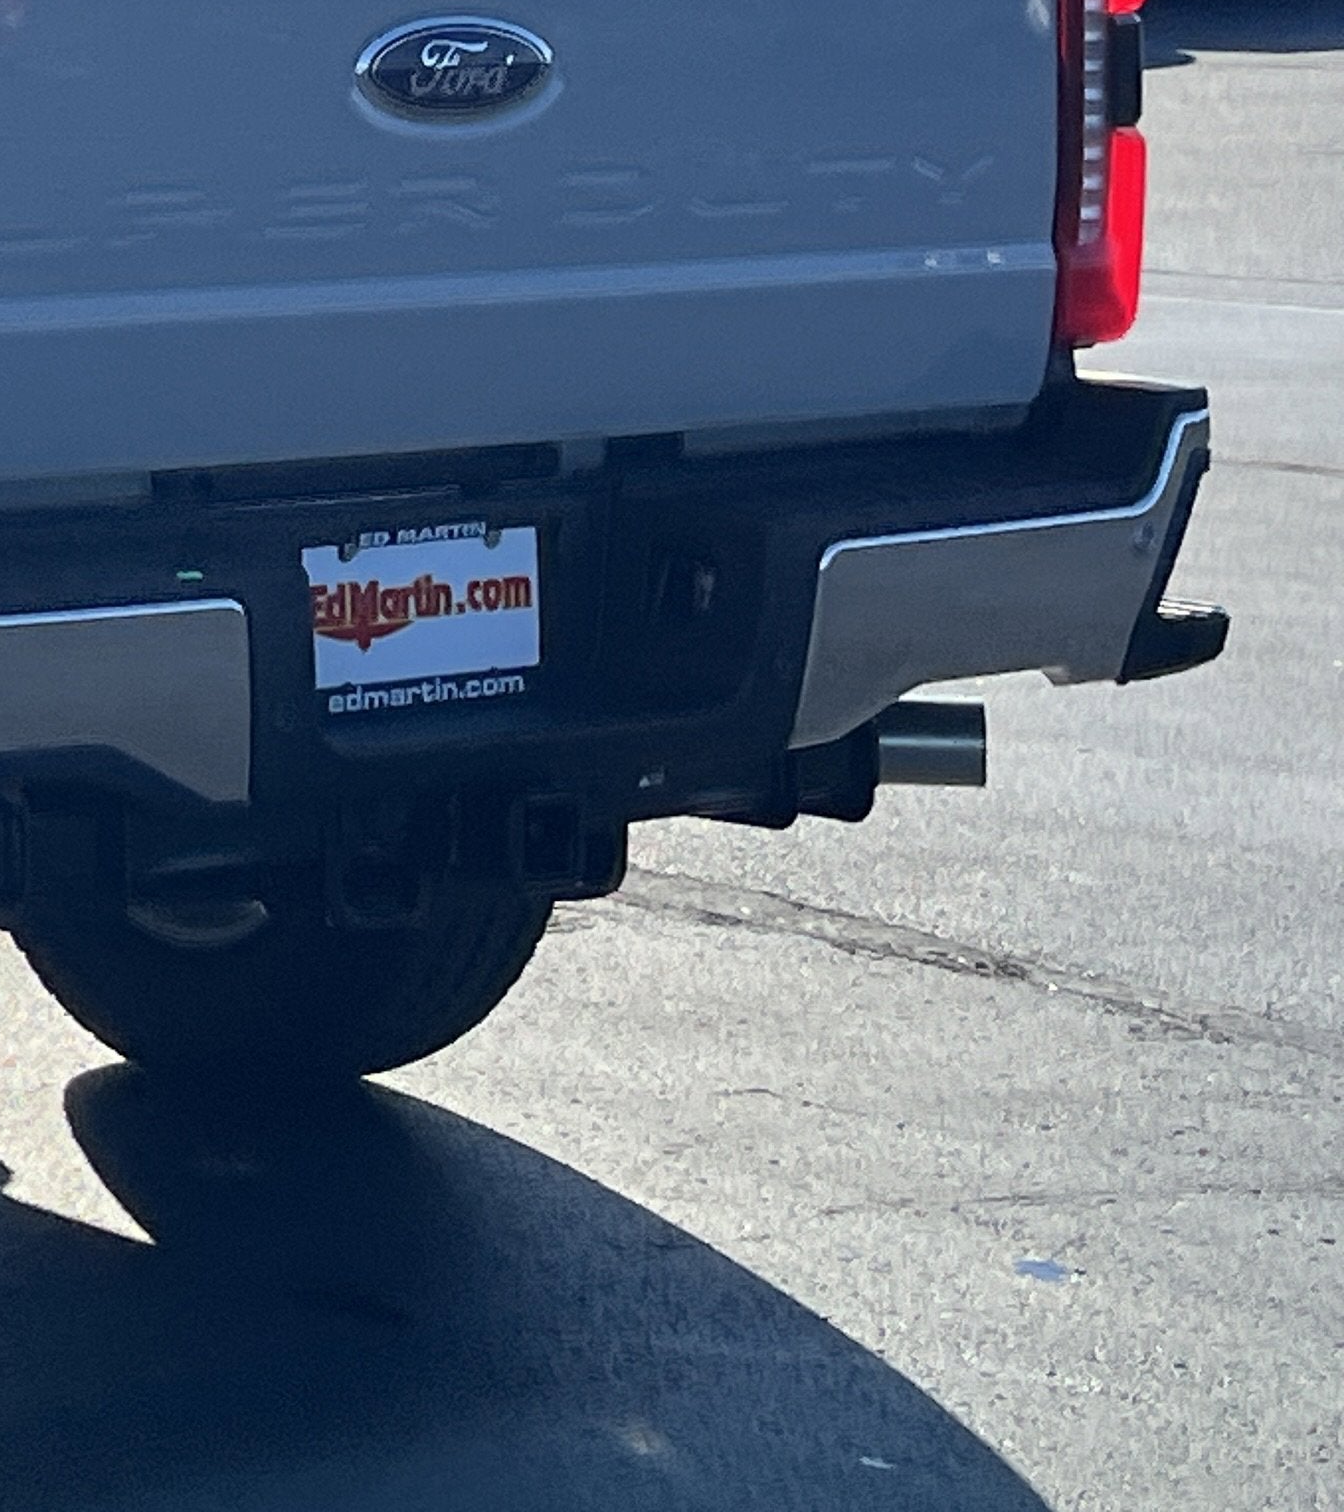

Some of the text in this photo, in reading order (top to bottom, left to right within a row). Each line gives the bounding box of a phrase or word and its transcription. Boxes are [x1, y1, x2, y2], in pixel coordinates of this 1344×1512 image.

[410, 38, 516, 97] Ford
[359, 521, 486, 548] ED MARTIN
[310, 574, 532, 628] EdMartin.com
[328, 674, 526, 713] edmartin.com
